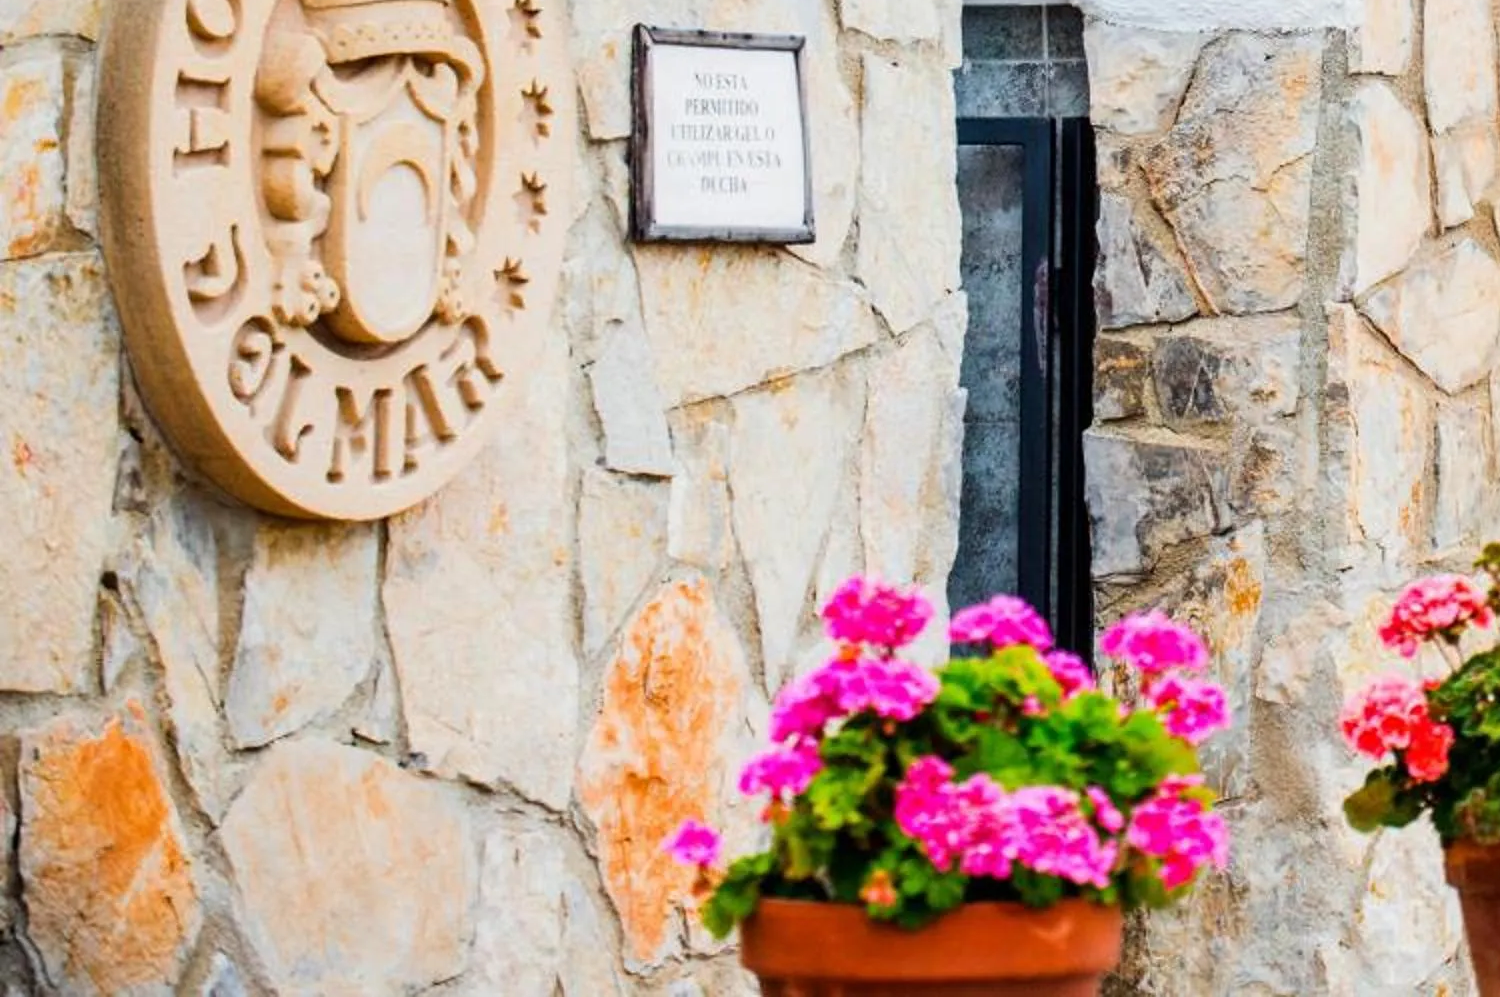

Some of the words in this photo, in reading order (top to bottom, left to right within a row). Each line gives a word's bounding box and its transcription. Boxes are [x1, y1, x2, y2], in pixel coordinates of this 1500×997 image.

[694, 73, 713, 90] NO
[685, 98, 759, 115] PERMITIDO
[671, 124, 732, 141] UTILIZAR
[735, 124, 762, 141] GEL
[765, 127, 775, 141] O
[701, 175, 747, 193] DUCHA
[326, 313, 503, 483] MAR
